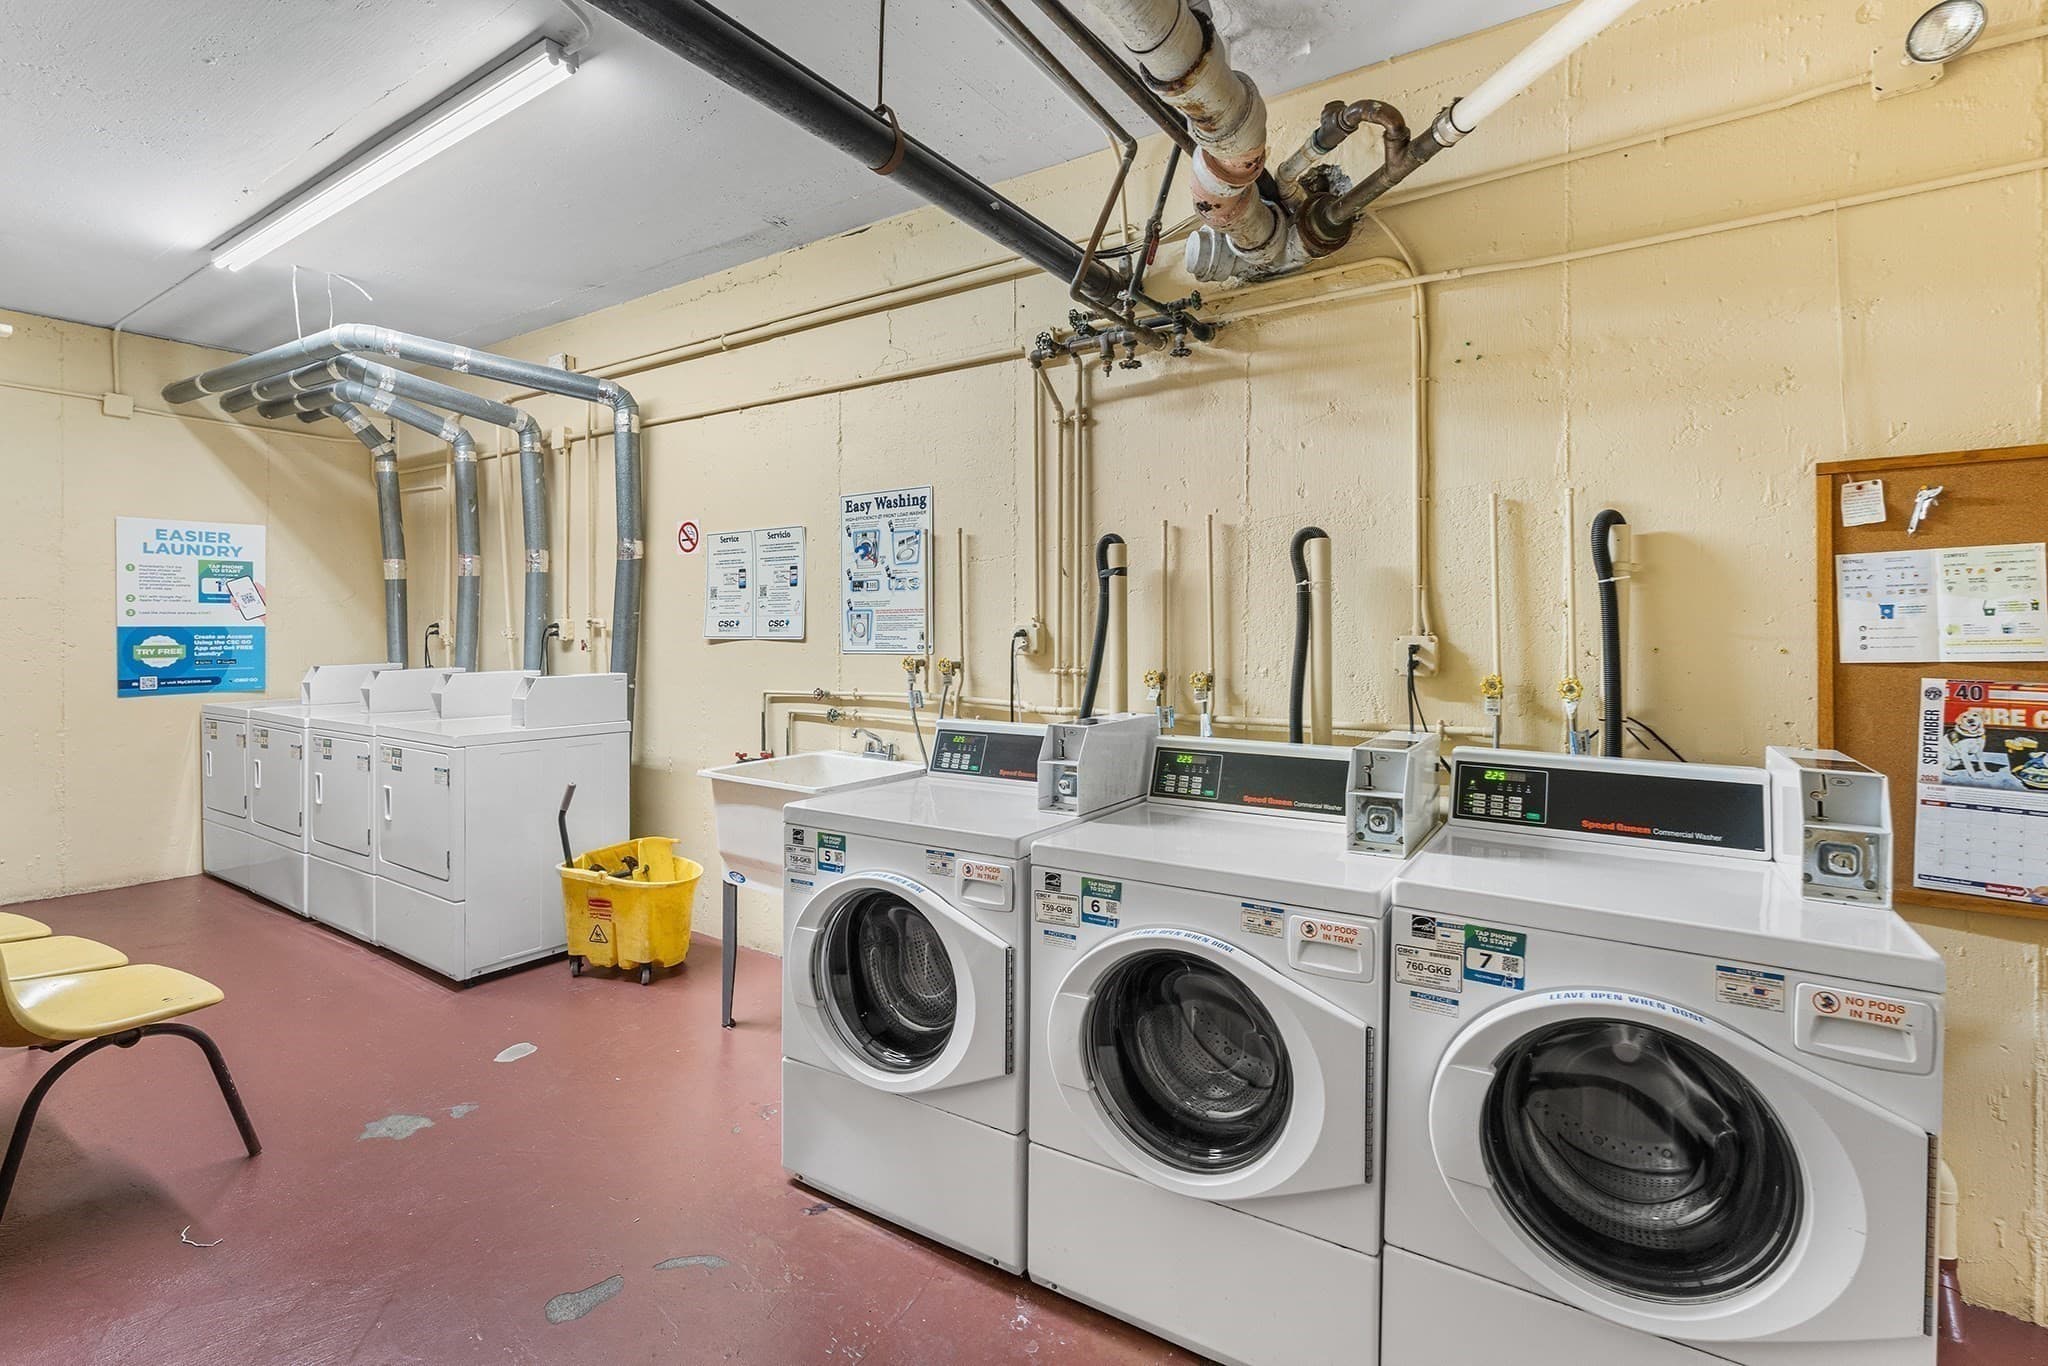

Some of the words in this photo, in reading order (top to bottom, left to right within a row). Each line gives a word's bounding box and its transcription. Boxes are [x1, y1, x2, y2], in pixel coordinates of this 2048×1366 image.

[845, 500, 872, 515] Easy
[874, 493, 927, 509] Washing
[155, 528, 231, 543] EASIER
[720, 535, 739, 543] Service
[767, 530, 791, 539] Servicio
[143, 542, 243, 558] LAUNDRY
[769, 619, 785, 627] CSC
[1955, 685, 1983, 700] 40
[1922, 709, 1940, 765] SEPTEMBER
[1176, 755, 1192, 763] 225
[1018, 770, 1037, 778] Queen
[1484, 770, 1505, 780] 225
[1242, 794, 1266, 804] Speed
[1268, 797, 1293, 806] Queen
[1293, 800, 1322, 809] Commercial
[1323, 803, 1343, 811] Washer
[1581, 819, 1614, 830] Speed
[1616, 823, 1651, 834] Queen
[1653, 828, 1694, 839] Commercial
[1695, 831, 1723, 842] Washer
[825, 850, 831, 861] 5
[984, 866, 1000, 874] PODS
[1042, 903, 1073, 914] 759-GKB
[1091, 900, 1100, 913] 6
[1320, 923, 1332, 932] NO
[1334, 925, 1358, 936] PODS
[1474, 929, 1489, 937] TAP
[1490, 932, 1517, 942] PHONE
[1184, 932, 1209, 943] WHEN
[1211, 940, 1234, 953] DONE
[1322, 933, 1331, 941] IN
[1333, 935, 1354, 944] TRAY
[1490, 938, 1514, 947] START
[1397, 947, 1413, 955] CSC
[1480, 953, 1492, 968] 7
[1405, 960, 1452, 976] 760-GKB
[1550, 992, 1585, 1001] LEAVE
[1590, 992, 1623, 1001] OPEN
[1628, 996, 1666, 1011] WHEN
[1671, 1006, 1707, 1025] DONE
[1845, 996, 1864, 1007] NO
[1868, 1001, 1906, 1014] PODS
[1849, 1009, 1862, 1018] IN
[1866, 1012, 1901, 1025] TRAY
